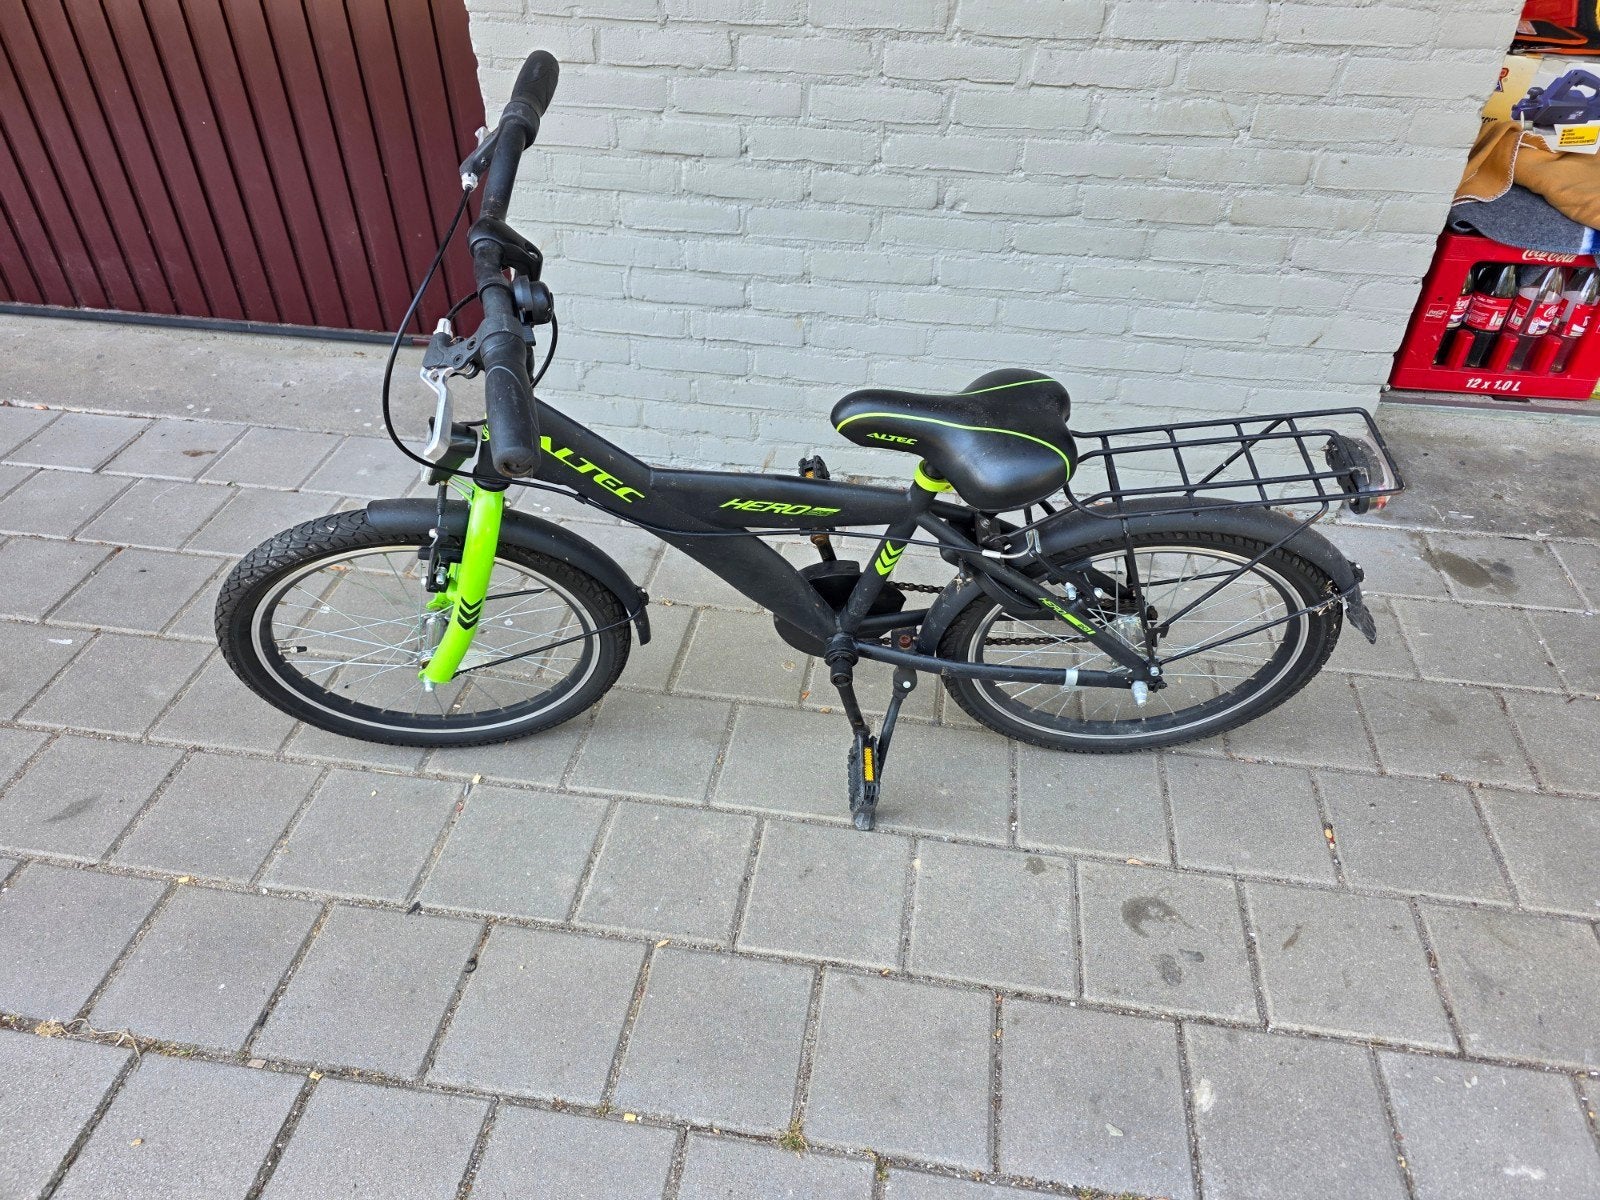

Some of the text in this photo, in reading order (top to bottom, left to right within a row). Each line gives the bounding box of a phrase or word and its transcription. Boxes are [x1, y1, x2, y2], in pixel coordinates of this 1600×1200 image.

[1466, 378, 1521, 391] 12 x 1.0 L
[866, 432, 917, 445] ALTEC
[719, 498, 812, 515] HERO
